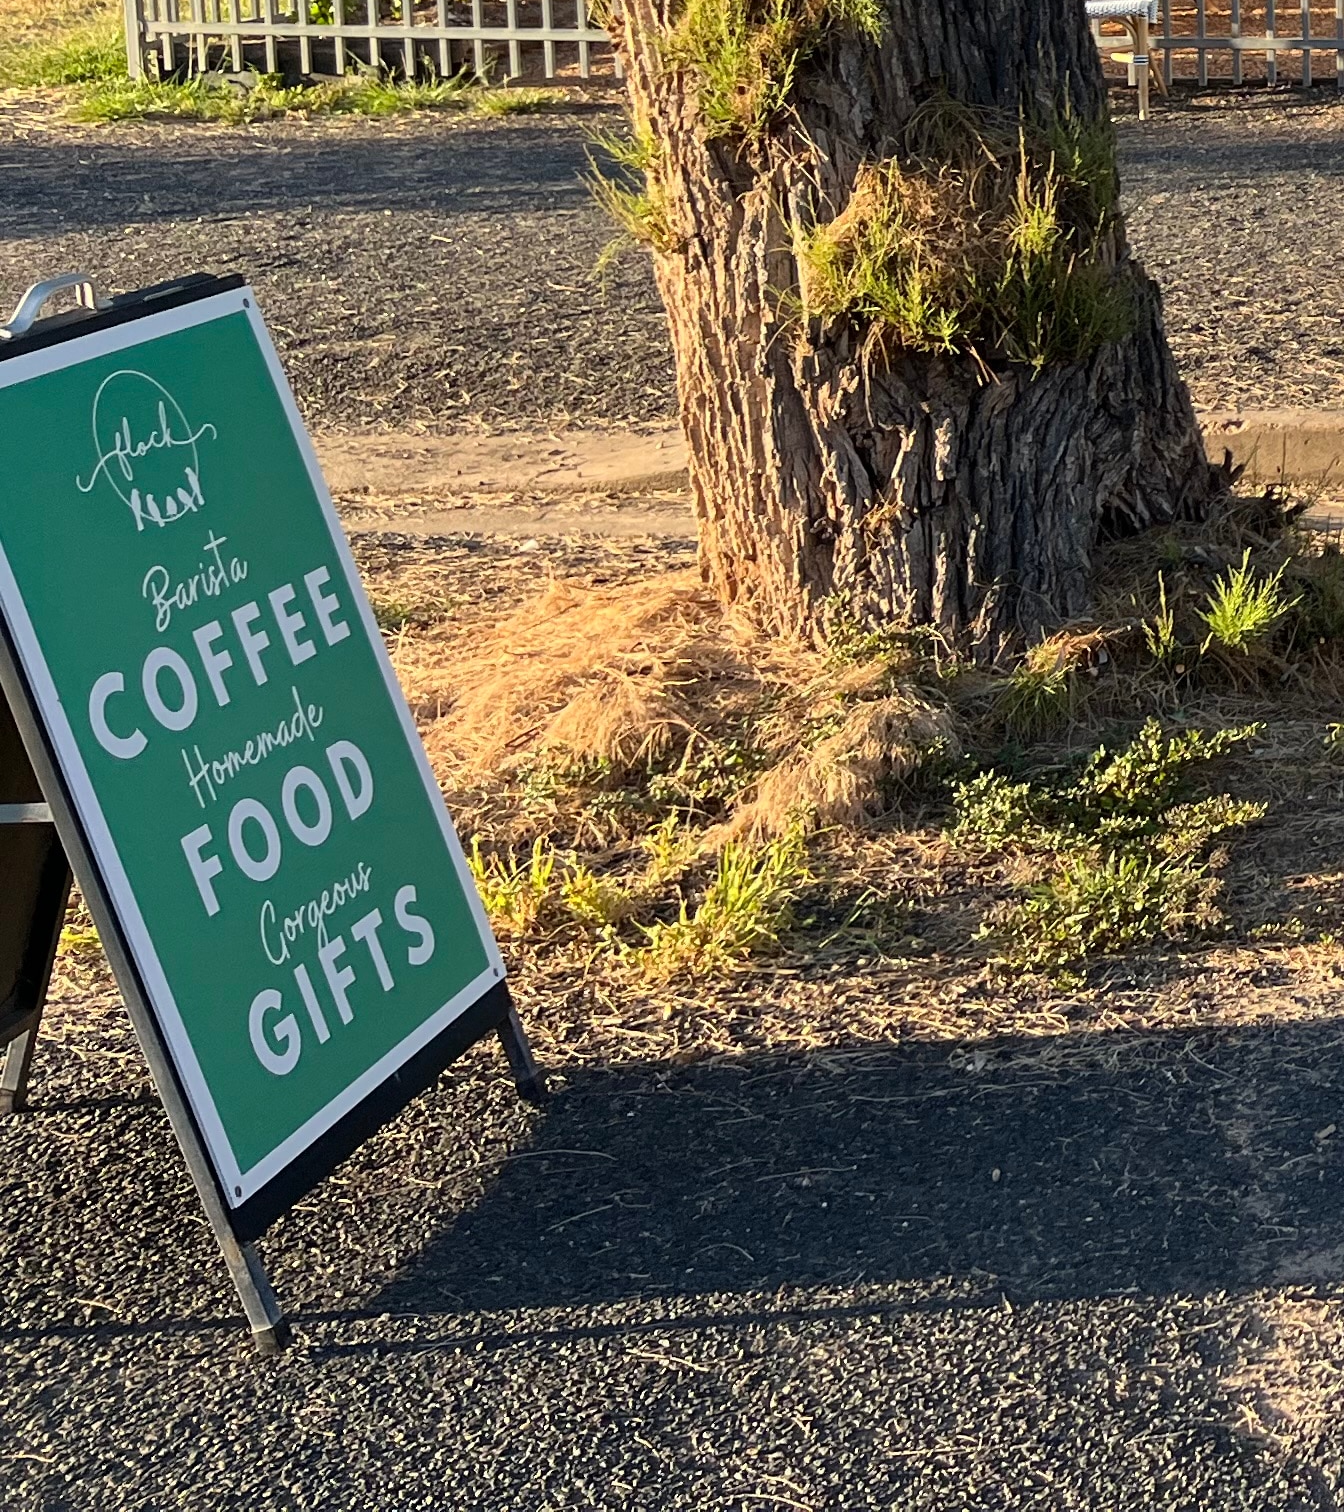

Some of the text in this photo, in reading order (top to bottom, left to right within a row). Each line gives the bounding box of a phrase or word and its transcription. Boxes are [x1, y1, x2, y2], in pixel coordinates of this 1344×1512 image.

[98, 400, 193, 483] flock
[142, 529, 248, 633] Barista
[88, 565, 351, 760] COFFEE
[181, 685, 324, 809] Homemade
[180, 740, 374, 917] FOOD
[260, 861, 373, 966] Gorgeous
[248, 884, 436, 1076] GIFTS
